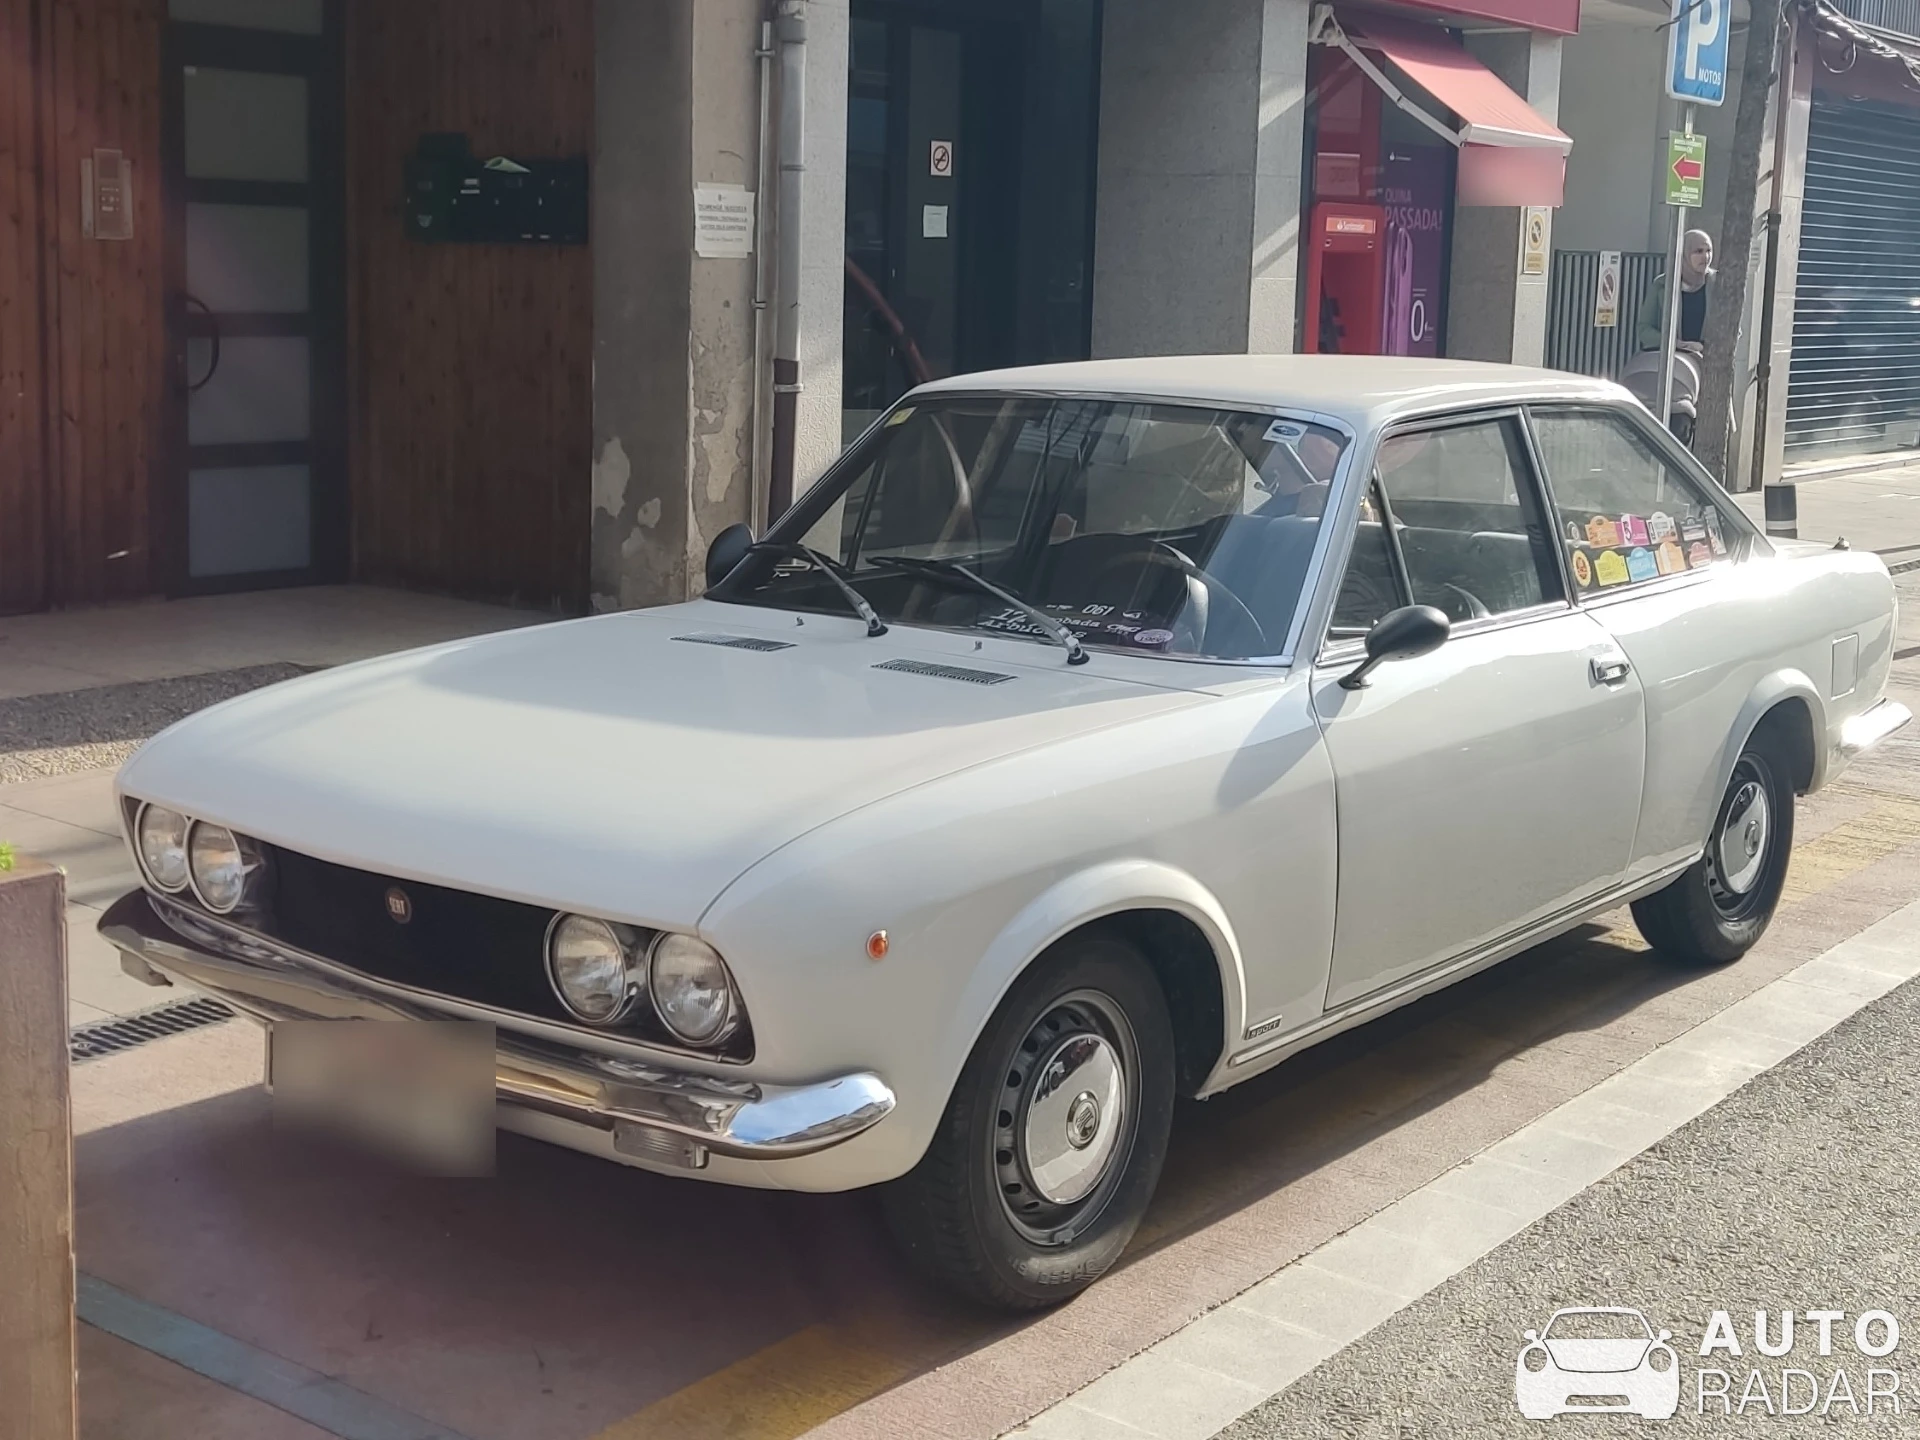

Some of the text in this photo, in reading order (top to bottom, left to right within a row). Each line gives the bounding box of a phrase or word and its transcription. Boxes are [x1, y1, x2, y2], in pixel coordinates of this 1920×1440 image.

[1684, 0, 1720, 80] P
[1698, 67, 1722, 86] MOTOS
[1384, 206, 1443, 232] PASSADA!
[1081, 604, 1115, 617] 061
